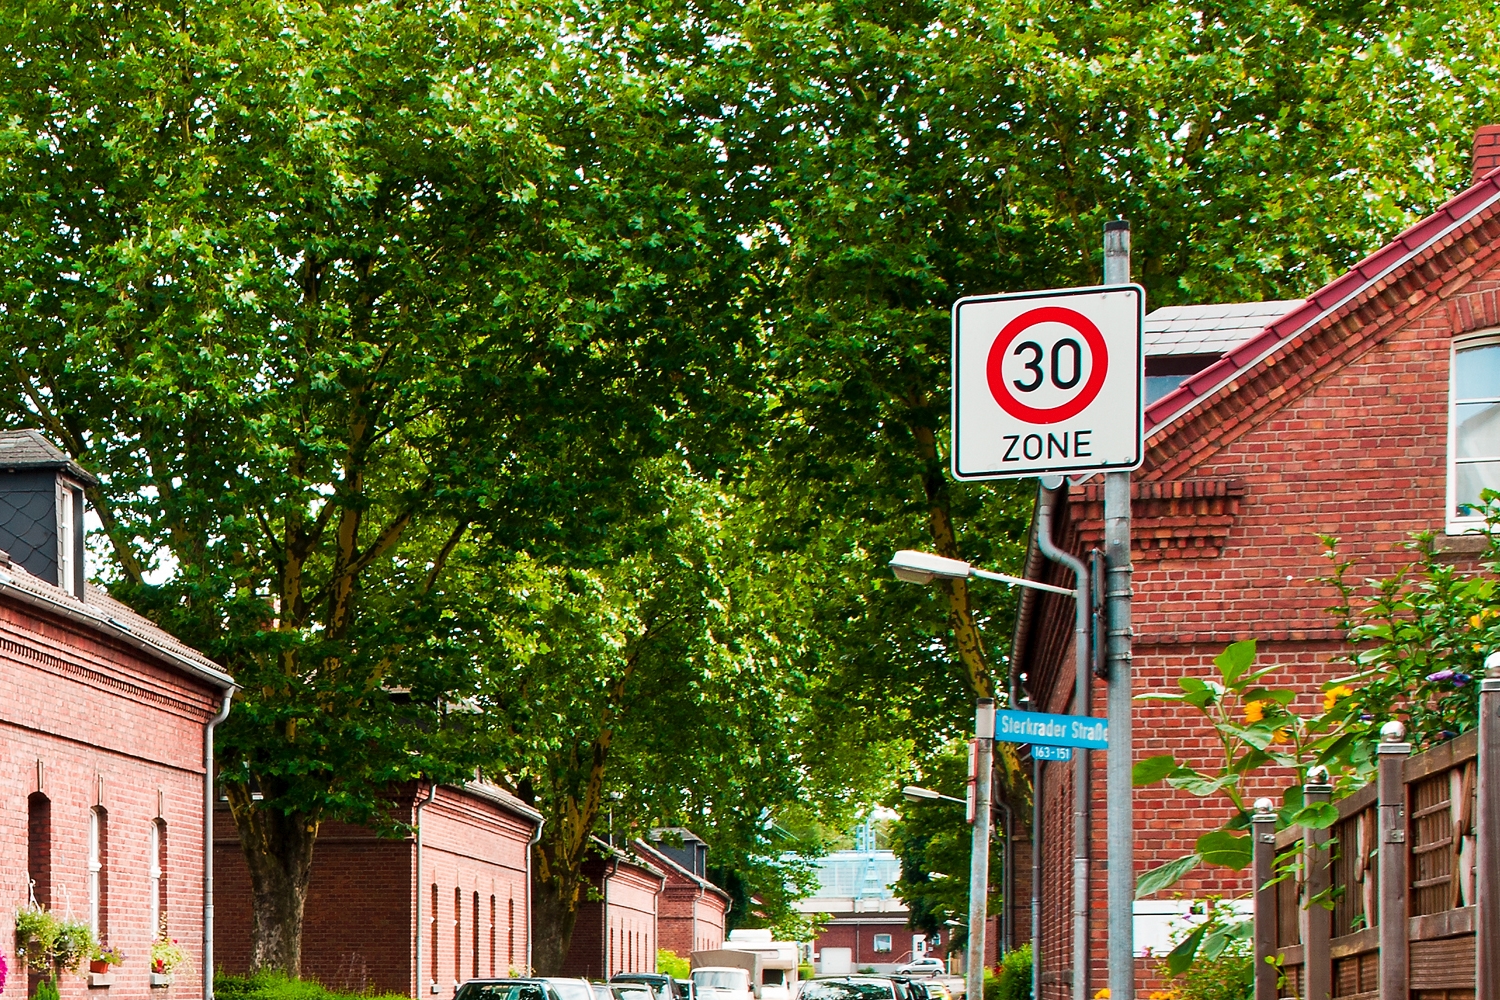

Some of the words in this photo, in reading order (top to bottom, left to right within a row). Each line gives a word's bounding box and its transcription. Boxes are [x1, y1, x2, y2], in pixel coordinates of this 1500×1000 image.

[1012, 338, 1082, 393] 30
[1002, 430, 1093, 462] ZONE
[1001, 715, 1067, 738] Sterkrader
